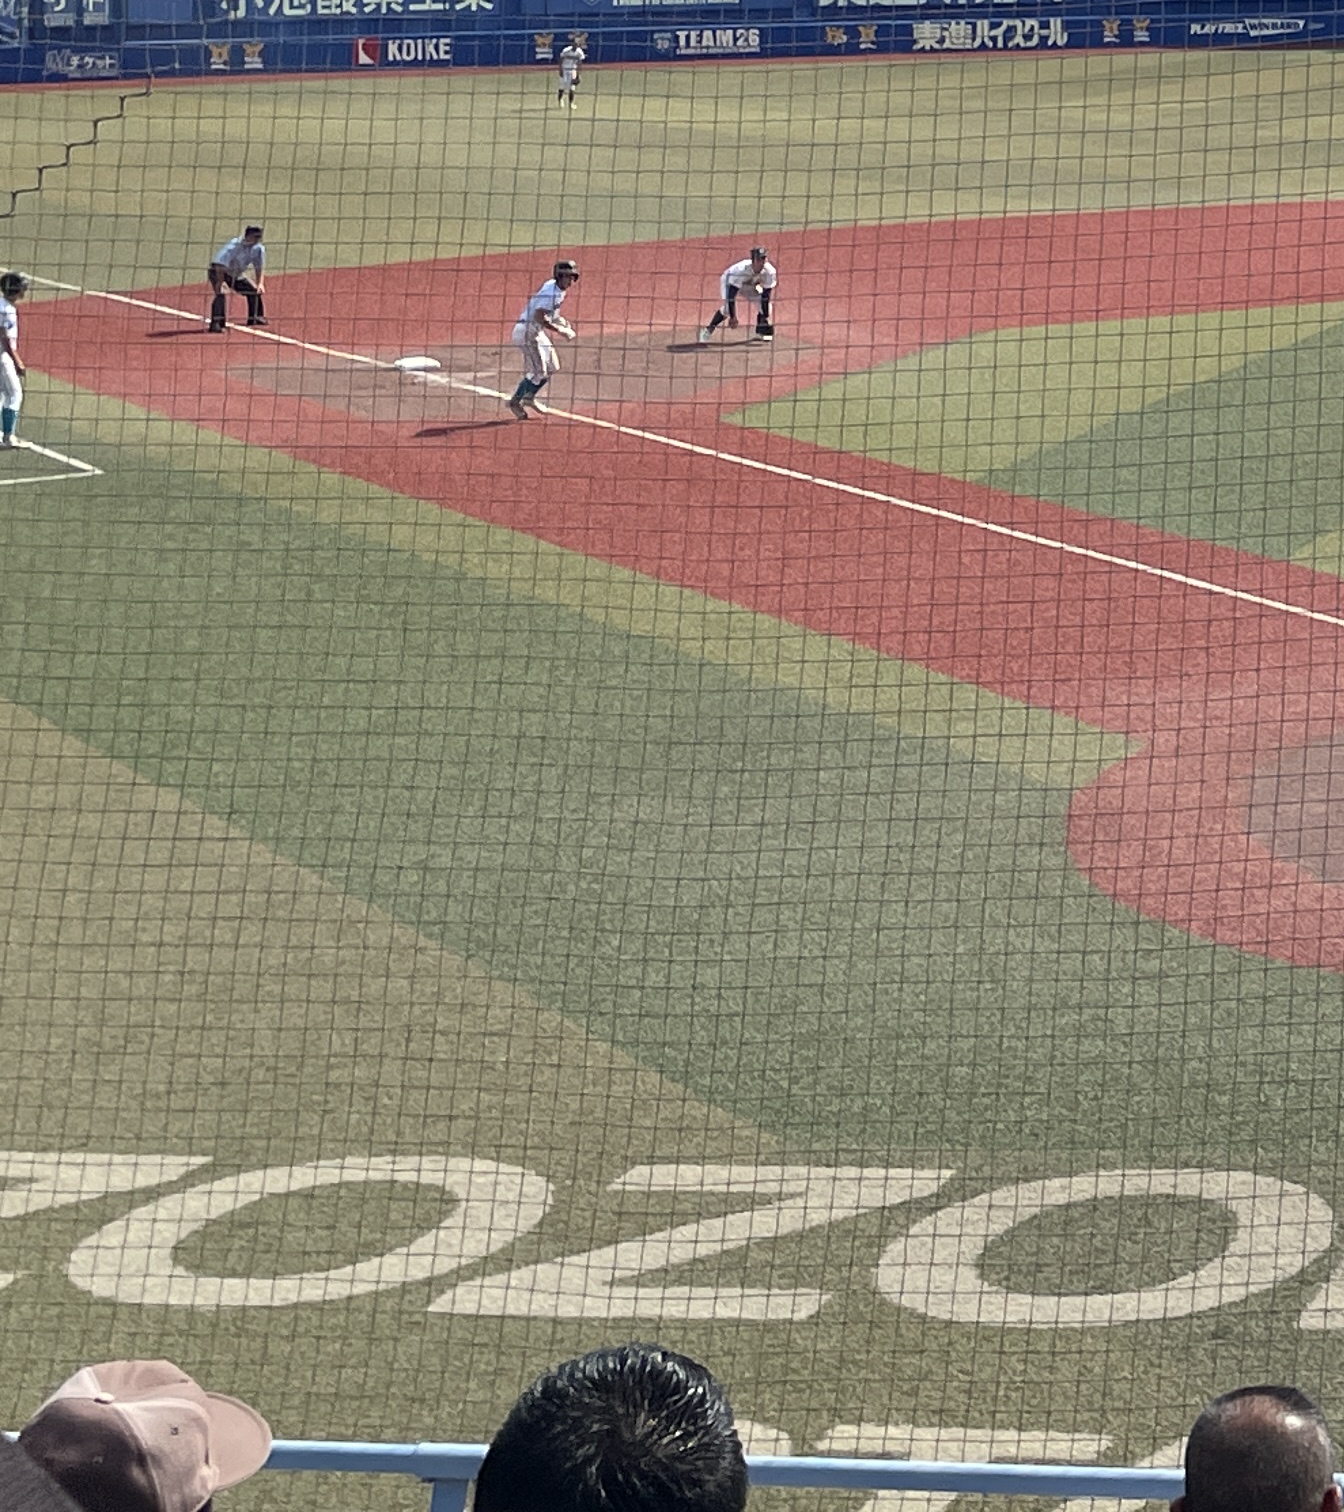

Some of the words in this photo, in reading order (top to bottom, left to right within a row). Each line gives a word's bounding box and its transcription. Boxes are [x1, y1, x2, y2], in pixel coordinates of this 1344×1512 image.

[912, 17, 1068, 50] 東進ハイスクール
[387, 39, 452, 61] KOIKE
